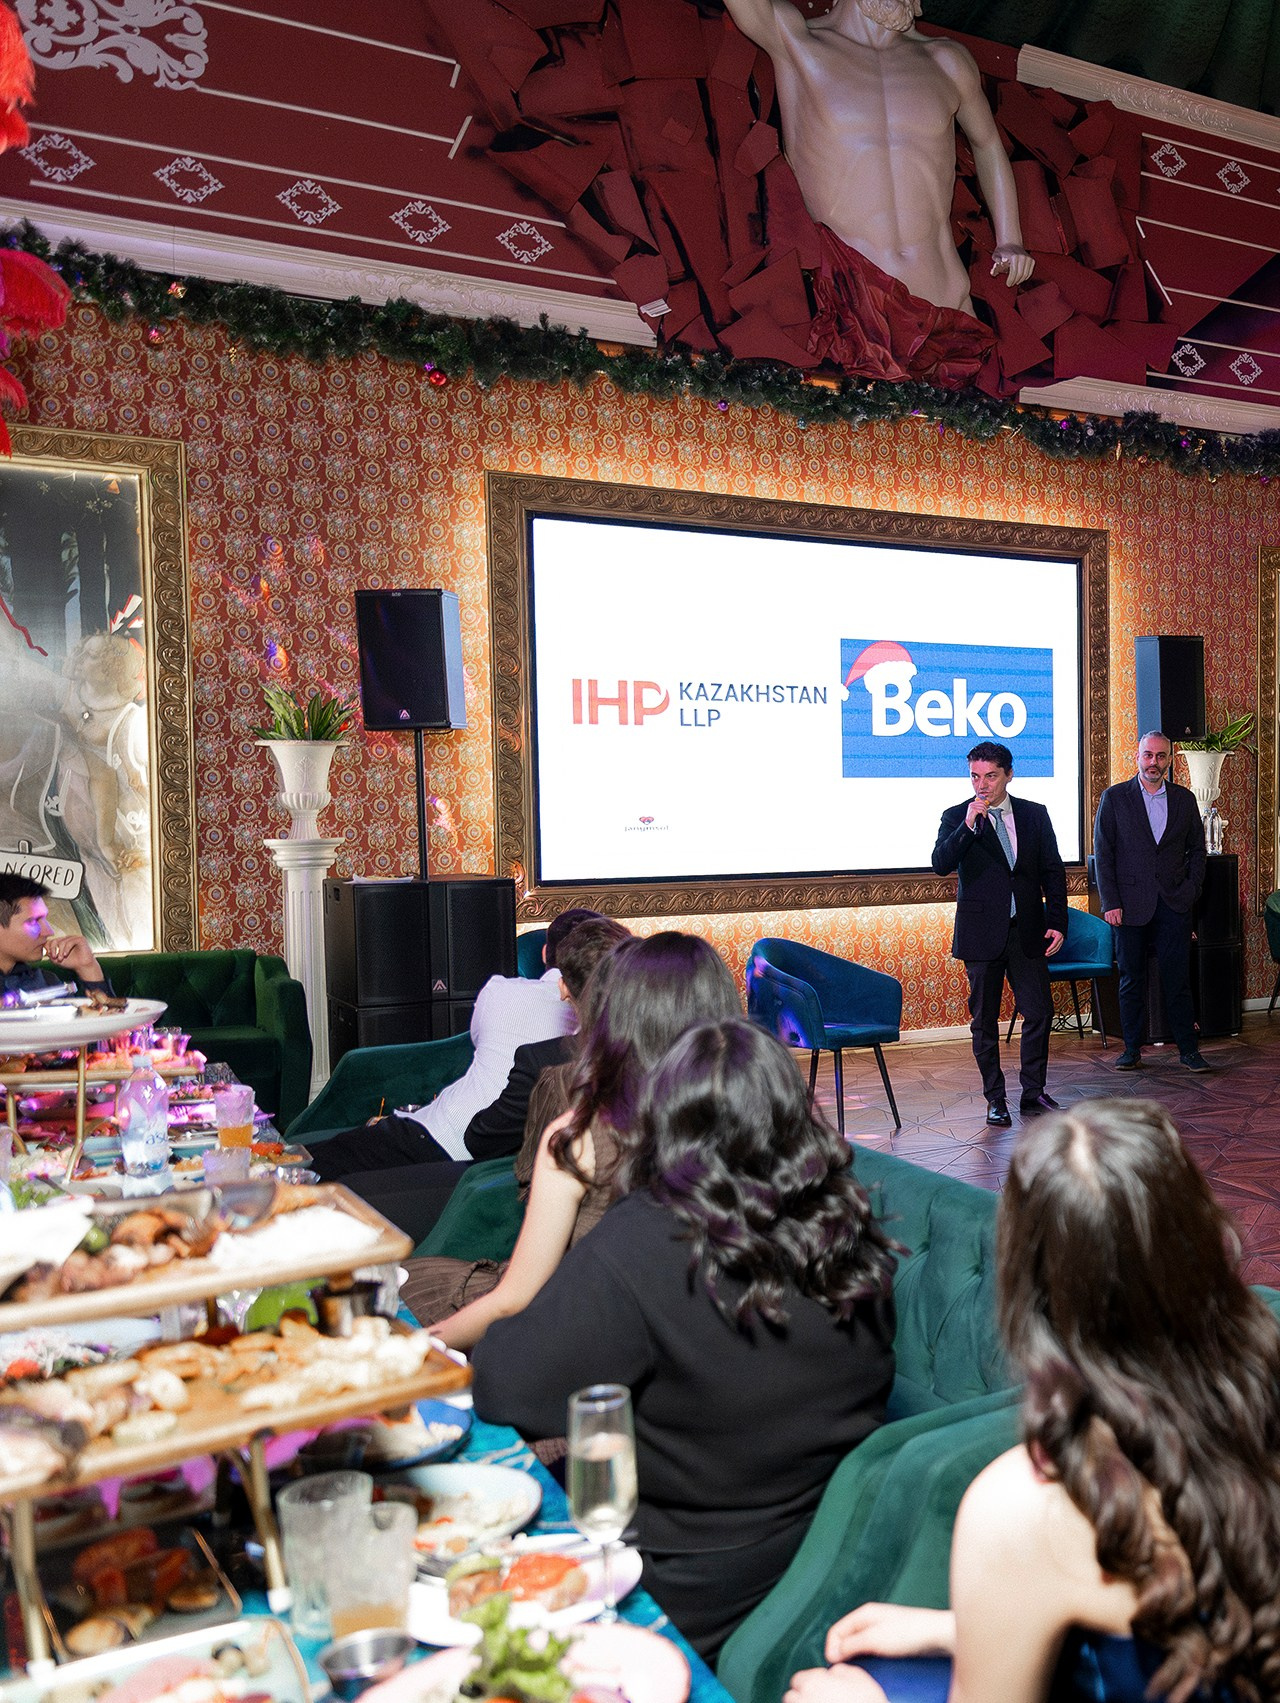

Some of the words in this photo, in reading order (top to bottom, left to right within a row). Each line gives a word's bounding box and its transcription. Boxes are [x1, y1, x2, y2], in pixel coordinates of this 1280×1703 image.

[572, 679, 670, 725] IHP
[679, 682, 828, 704] KAZAKHSTAN
[871, 677, 1028, 738] Beko
[679, 708, 721, 727] LLP
